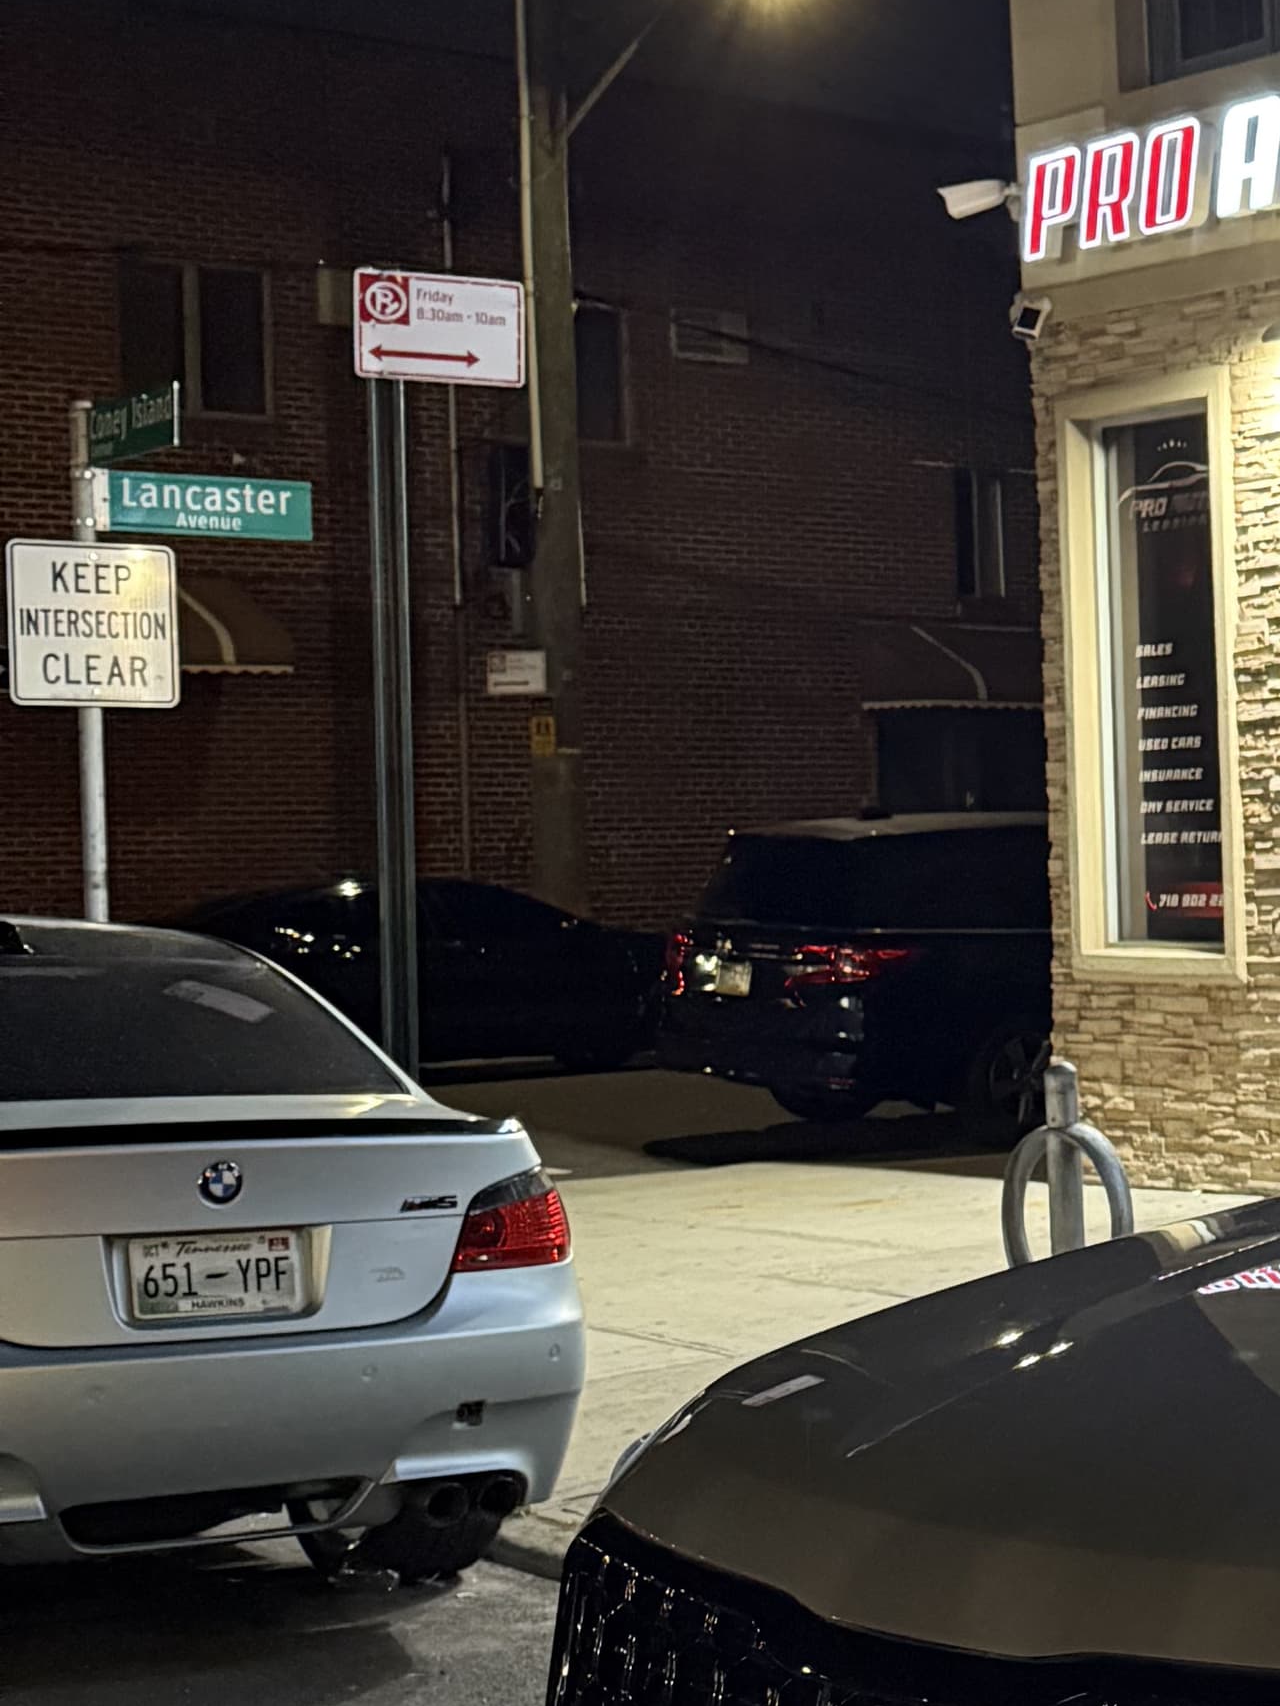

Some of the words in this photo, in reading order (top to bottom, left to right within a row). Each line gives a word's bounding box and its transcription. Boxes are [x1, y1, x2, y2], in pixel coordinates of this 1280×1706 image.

[1023, 116, 1200, 263] PRO
[416, 289, 455, 305] Friday
[475, 312, 506, 326] 10am
[122, 478, 292, 515] Lancaster
[1129, 496, 1168, 521] PRO
[176, 512, 242, 532] Avenue
[51, 560, 132, 595] KEEP
[19, 608, 167, 640] INTERSECTION
[1136, 643, 1173, 658] SALES
[42, 653, 149, 687] CLEAR
[1136, 673, 1185, 689] LEASING
[1137, 704, 1198, 721] FINANCING
[1138, 737, 1168, 751] USED
[1171, 735, 1202, 750] CARS
[1139, 768, 1203, 783] INSURANCE
[1165, 799, 1214, 812] SERVICE
[1141, 832, 1179, 845] LEASE
[175, 1240, 252, 1258] Tennessee
[143, 1262, 198, 1298] 651
[236, 1256, 290, 1293] YPF
[191, 1297, 245, 1310] HAWKINS
